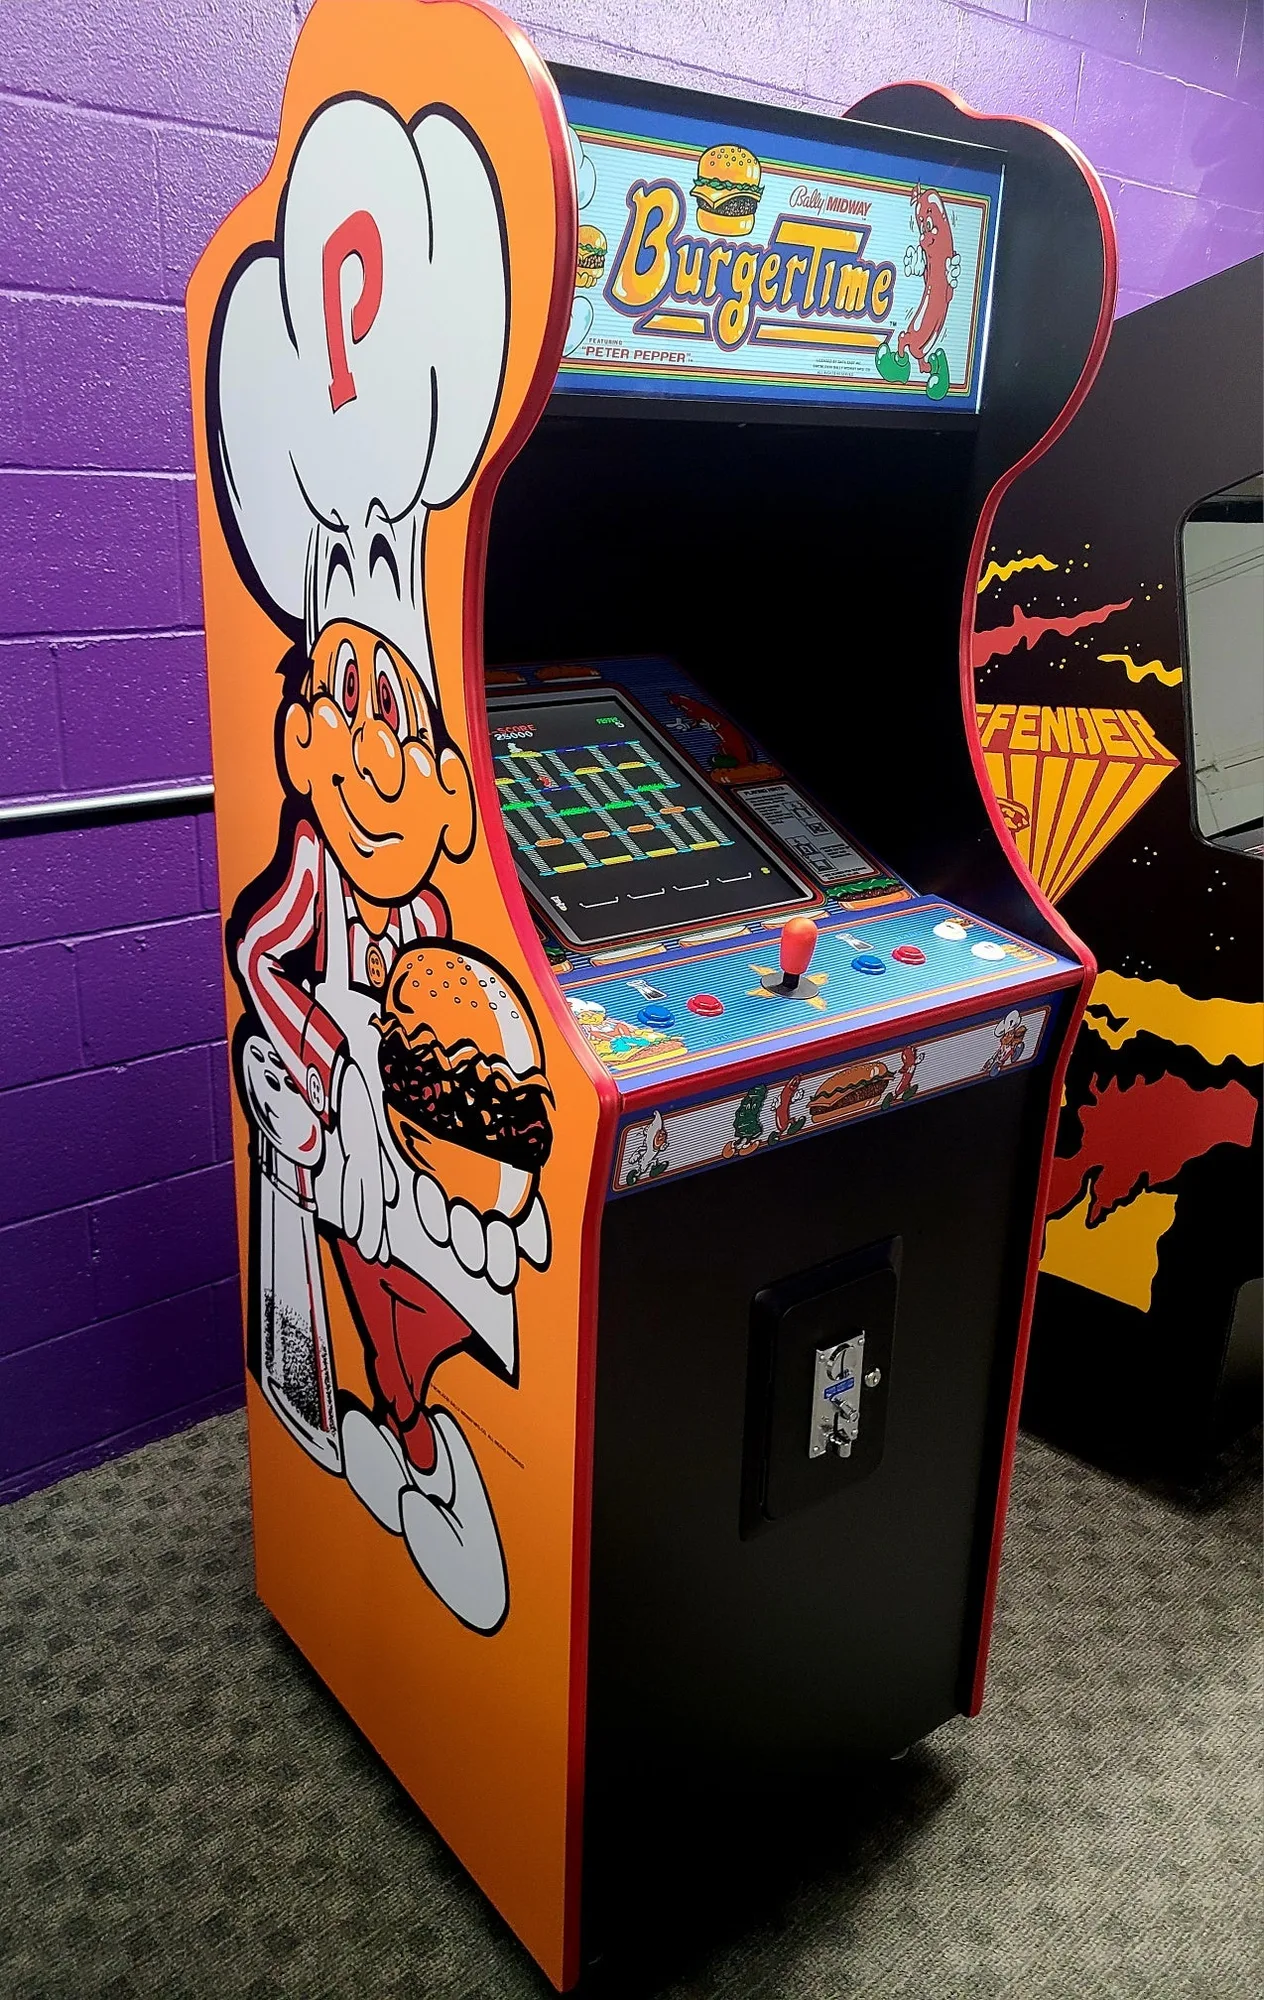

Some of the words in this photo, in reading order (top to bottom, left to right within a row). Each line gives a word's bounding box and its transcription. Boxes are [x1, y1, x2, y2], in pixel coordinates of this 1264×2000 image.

[789, 184, 826, 216] Bally
[826, 196, 872, 217] MIDWAY
[588, 337, 623, 346] FEATURING
